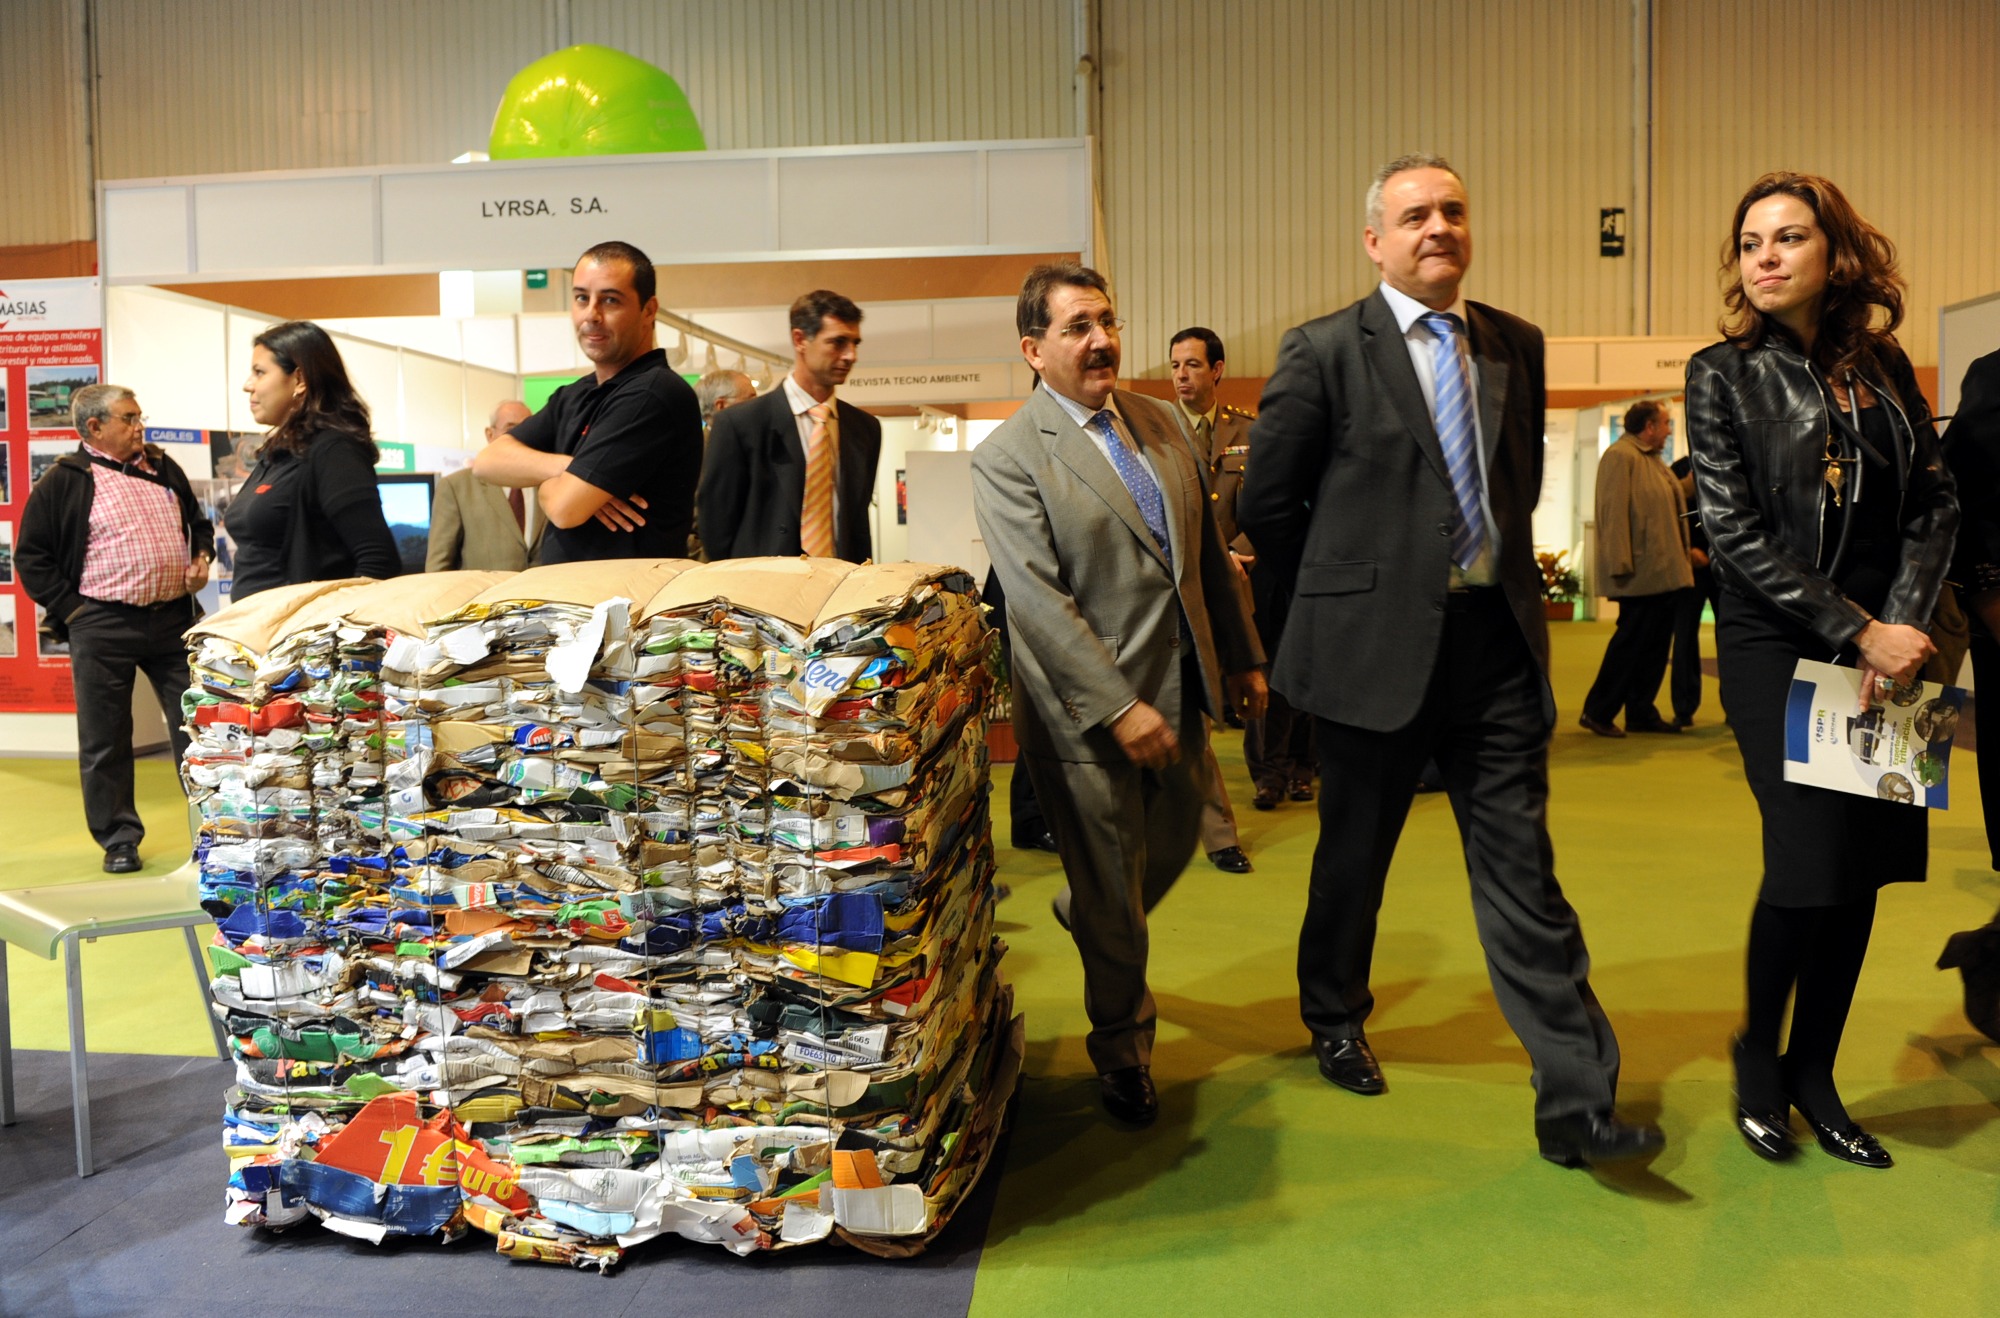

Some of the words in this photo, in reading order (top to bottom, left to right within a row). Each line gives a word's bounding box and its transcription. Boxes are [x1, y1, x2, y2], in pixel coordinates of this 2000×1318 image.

[482, 199, 556, 218] LYRSA,
[570, 197, 608, 214] S.A.
[850, 377, 890, 387] REVISTA
[894, 375, 927, 385] TECNO
[929, 373, 981, 383] AMBIENTE
[151, 430, 194, 442] CABLES
[1900, 716, 1912, 763] trituración
[379, 1124, 420, 1185] 1
